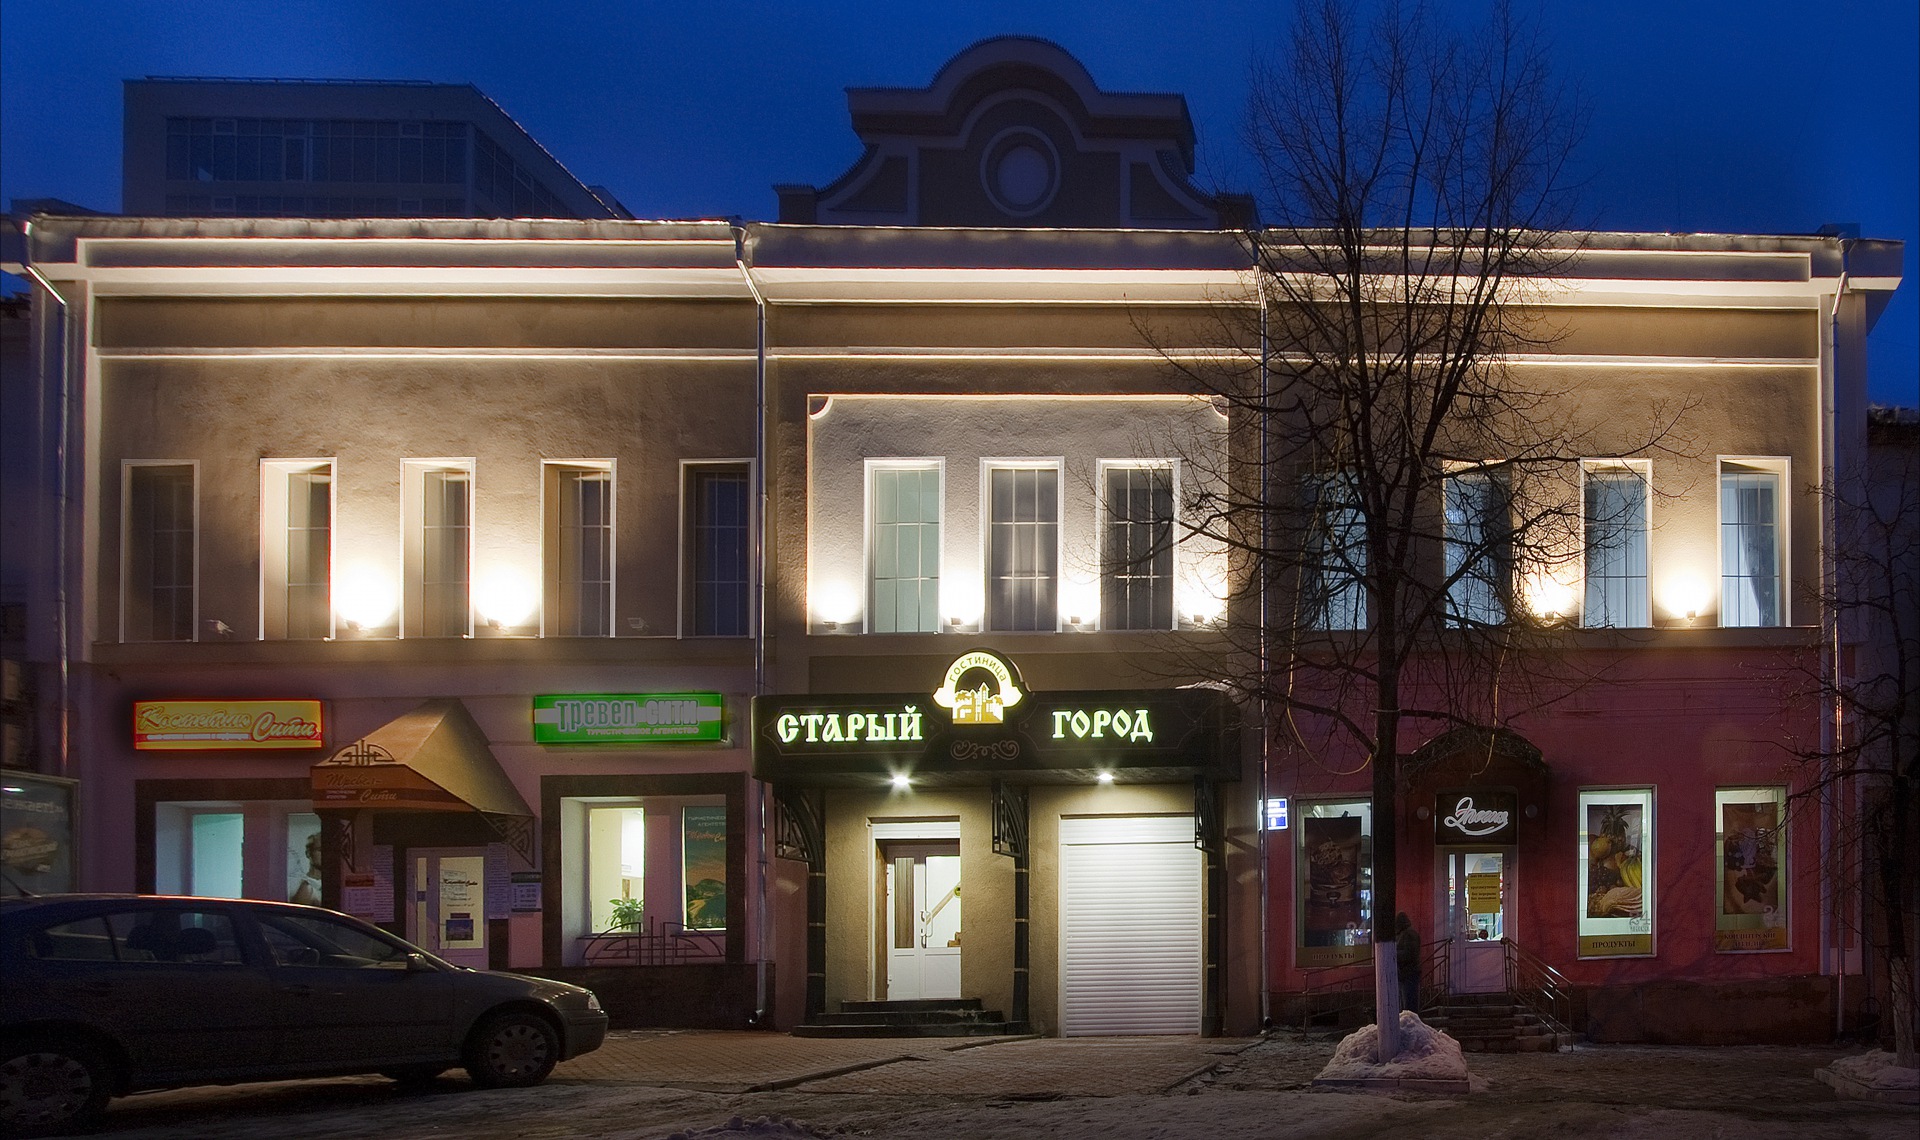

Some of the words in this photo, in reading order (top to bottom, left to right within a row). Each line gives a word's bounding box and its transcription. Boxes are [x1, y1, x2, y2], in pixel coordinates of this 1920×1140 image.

[777, 705, 923, 743] СТАРЫЙ
[1052, 709, 1154, 743] ГОРОД
[360, 788, 399, 804] Сити
[1592, 940, 1636, 949] ПРОДУКТЫ
